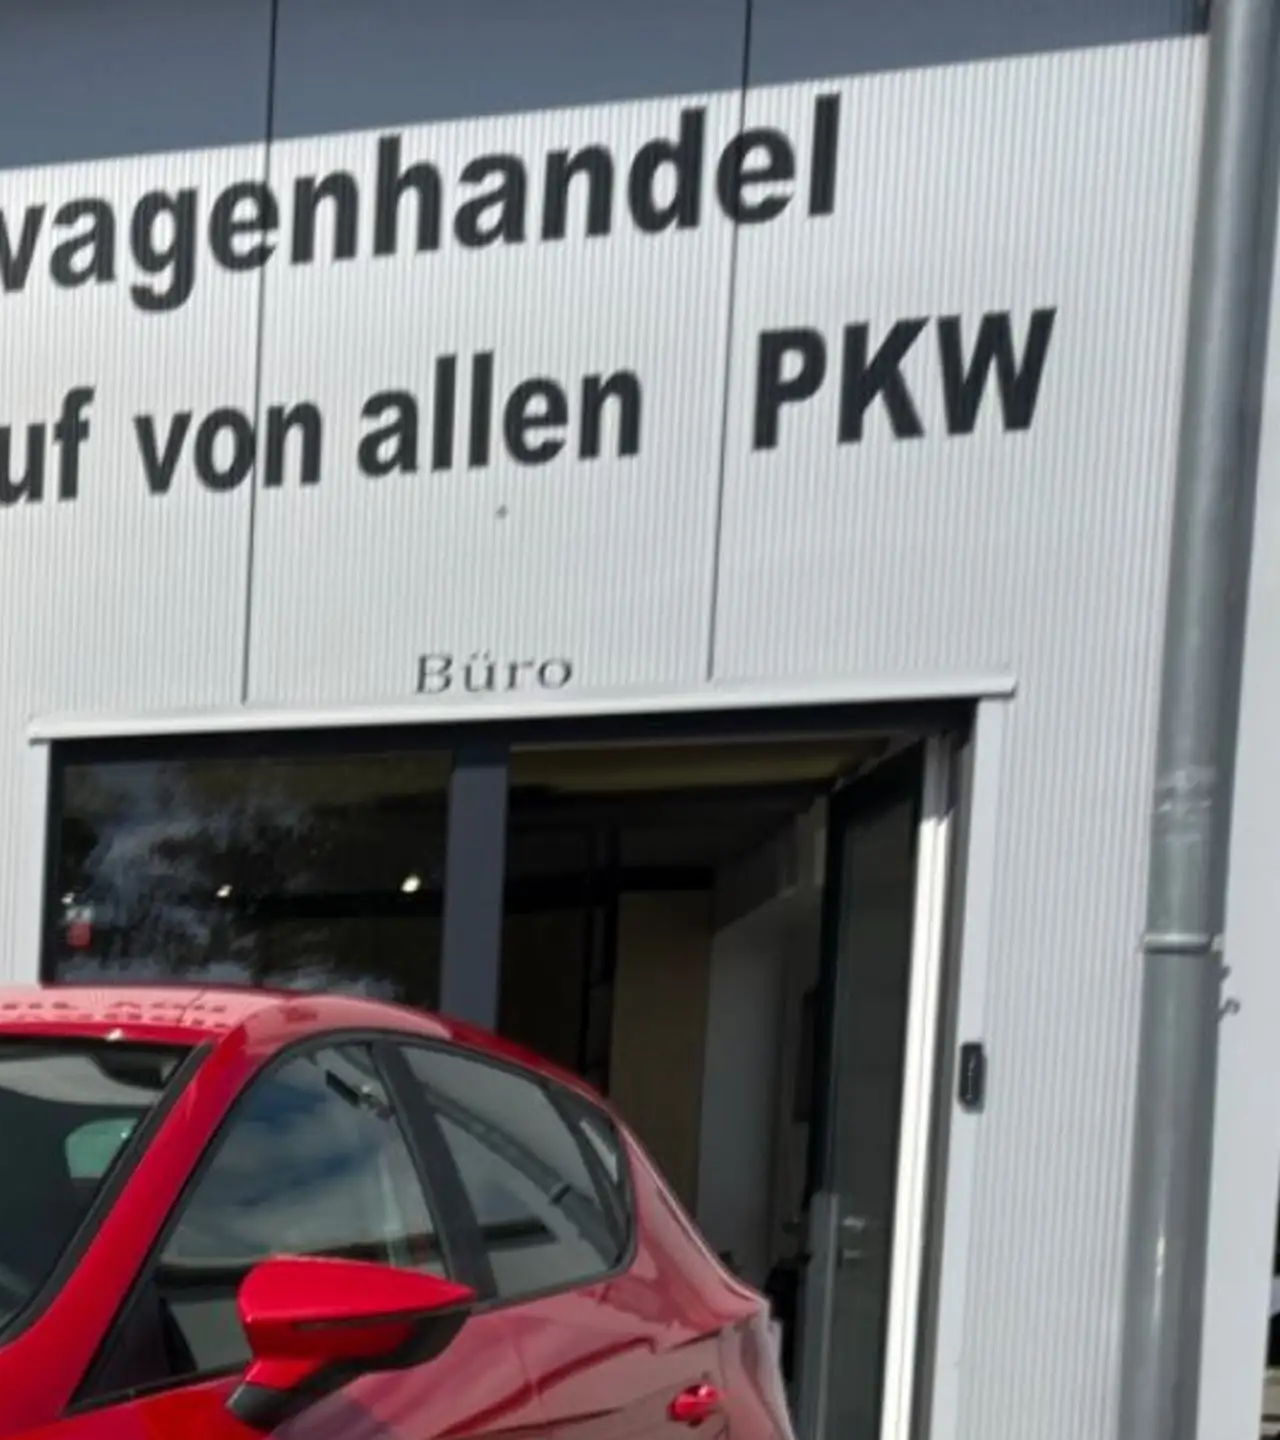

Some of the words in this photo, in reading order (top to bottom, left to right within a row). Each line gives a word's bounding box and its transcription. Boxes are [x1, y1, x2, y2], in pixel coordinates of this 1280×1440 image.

[134, 399, 322, 496] von
[356, 350, 641, 477] allen
[751, 306, 1057, 450] PKW
[415, 651, 573, 694] Büro
